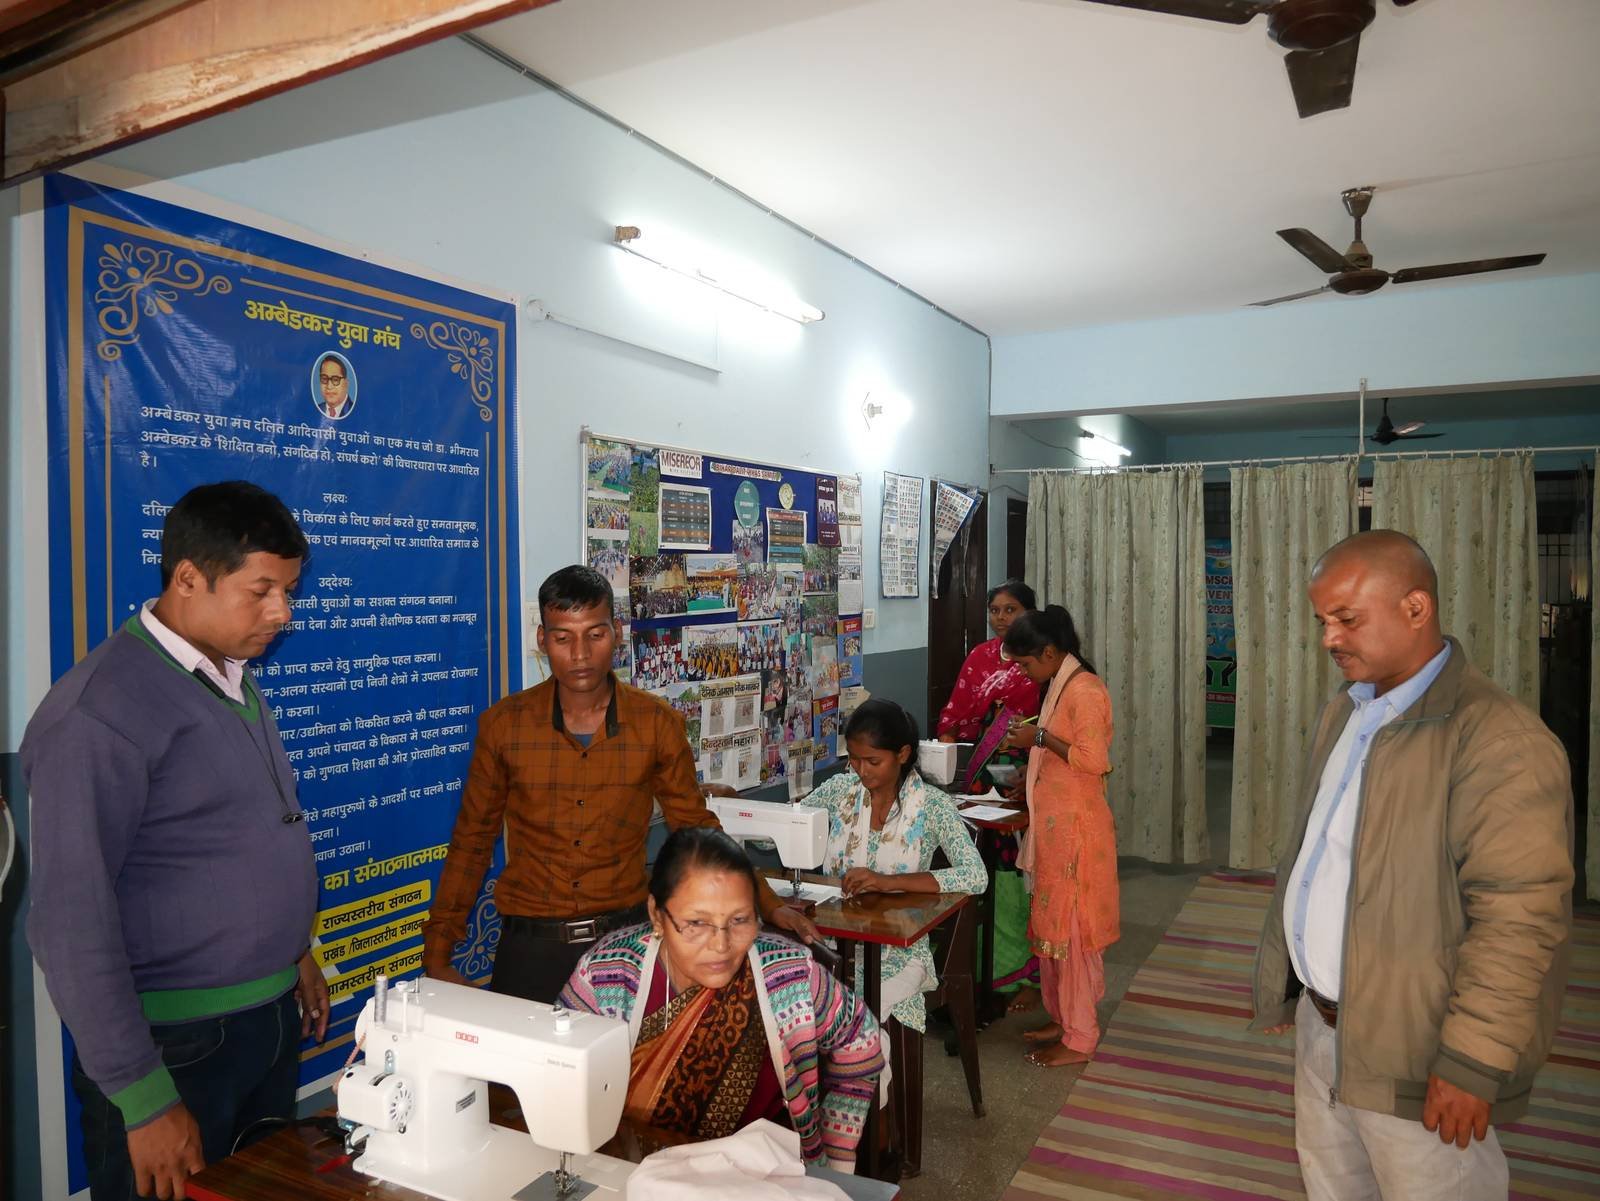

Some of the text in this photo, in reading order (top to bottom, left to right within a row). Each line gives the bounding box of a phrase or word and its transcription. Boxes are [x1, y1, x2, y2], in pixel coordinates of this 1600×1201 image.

[244, 300, 401, 350] अम्बेडकर युवा मंच
[140, 404, 200, 423] अम्बेडकर
[203, 414, 227, 430] युवा
[230, 415, 251, 429] मंच
[254, 418, 285, 434] दलित
[288, 422, 336, 440] आदिवासी
[339, 431, 370, 445] युवाओं
[373, 436, 386, 446] का
[387, 438, 403, 448] एक
[405, 440, 420, 450] मंच
[421, 440, 433, 452] जो
[450, 443, 479, 459] भीमराव
[141, 429, 198, 448] अम्बेडकर
[200, 433, 211, 448] के
[256, 441, 280, 458] बनो,
[283, 444, 320, 462] संगठित
[336, 450, 359, 463] संघर्ष
[382, 454, 394, 467] की
[395, 455, 438, 471] विचारधारा
[438, 461, 448, 473] पर
[449, 463, 479, 475] आधारित
[661, 451, 701, 471] MISEREOR
[302, 509, 337, 524] विकास
[339, 511, 348, 524] के
[350, 512, 370, 526] लिए
[371, 513, 391, 526] कार्य
[393, 515, 414, 527] करते
[416, 519, 429, 531] हुए
[323, 533, 337, 546] एवं
[340, 534, 391, 550] मानवमूल्यों
[394, 538, 408, 547] पर
[409, 535, 444, 548] आधारित
[445, 539, 470, 548] समाज
[472, 537, 479, 548] के
[320, 594, 351, 612] युवाओं
[353, 598, 366, 607] का
[368, 597, 396, 607] सशक्त
[399, 596, 426, 606] संगठन
[308, 617, 326, 630] देना
[330, 615, 347, 629] और
[350, 614, 377, 627] अपनी
[380, 613, 413, 627] शैक्षणिक
[415, 615, 438, 624] दक्षता
[440, 614, 450, 623] का
[451, 613, 478, 626] मजबूत
[267, 662, 281, 676] को
[284, 664, 307, 675] प्राप्त
[310, 658, 334, 672] करने
[336, 657, 350, 673] हेतु
[352, 654, 390, 672] सामुहिक
[391, 655, 411, 665] पहल
[414, 653, 441, 663] करना।
[310, 677, 347, 694] संस्थानों
[350, 674, 364, 690] एवं
[366, 673, 388, 688] निजी
[391, 672, 408, 685] क्षेत्रों
[410, 670, 419, 682] में
[421, 671, 448, 682] उपलब्ध
[450, 666, 478, 678] रोजगार
[286, 705, 319, 717] करना।
[339, 718, 352, 731] को
[355, 714, 390, 730] विकसित
[392, 710, 413, 724] करने
[415, 708, 426, 720] की
[429, 709, 447, 719] पहल
[449, 705, 473, 716] करना।
[307, 742, 331, 758] अपने
[334, 740, 366, 752] पंचायत
[369, 735, 378, 748] के
[380, 733, 407, 746] विकास
[409, 729, 418, 740] में
[421, 728, 439, 739] पहल
[440, 725, 466, 736] करना।
[303, 766, 316, 780] को
[319, 763, 349, 781] गुणवत
[352, 758, 376, 772] शिक्षा
[378, 753, 389, 766] की
[392, 750, 408, 763] ओर
[410, 744, 446, 761] प्रोत्साहित
[449, 742, 469, 753] करना
[368, 795, 378, 808] के
[409, 789, 421, 799] पर
[423, 781, 444, 796] चलने
[446, 778, 461, 791] वाले
[339, 840, 370, 856] उठाना।
[325, 843, 448, 890] का संगठनात्मक
[322, 892, 422, 929] राज्यस्तरीय संगठन
[322, 943, 346, 963] प्रखंड
[399, 920, 425, 936] संगठन
[388, 953, 425, 972] संगठन
